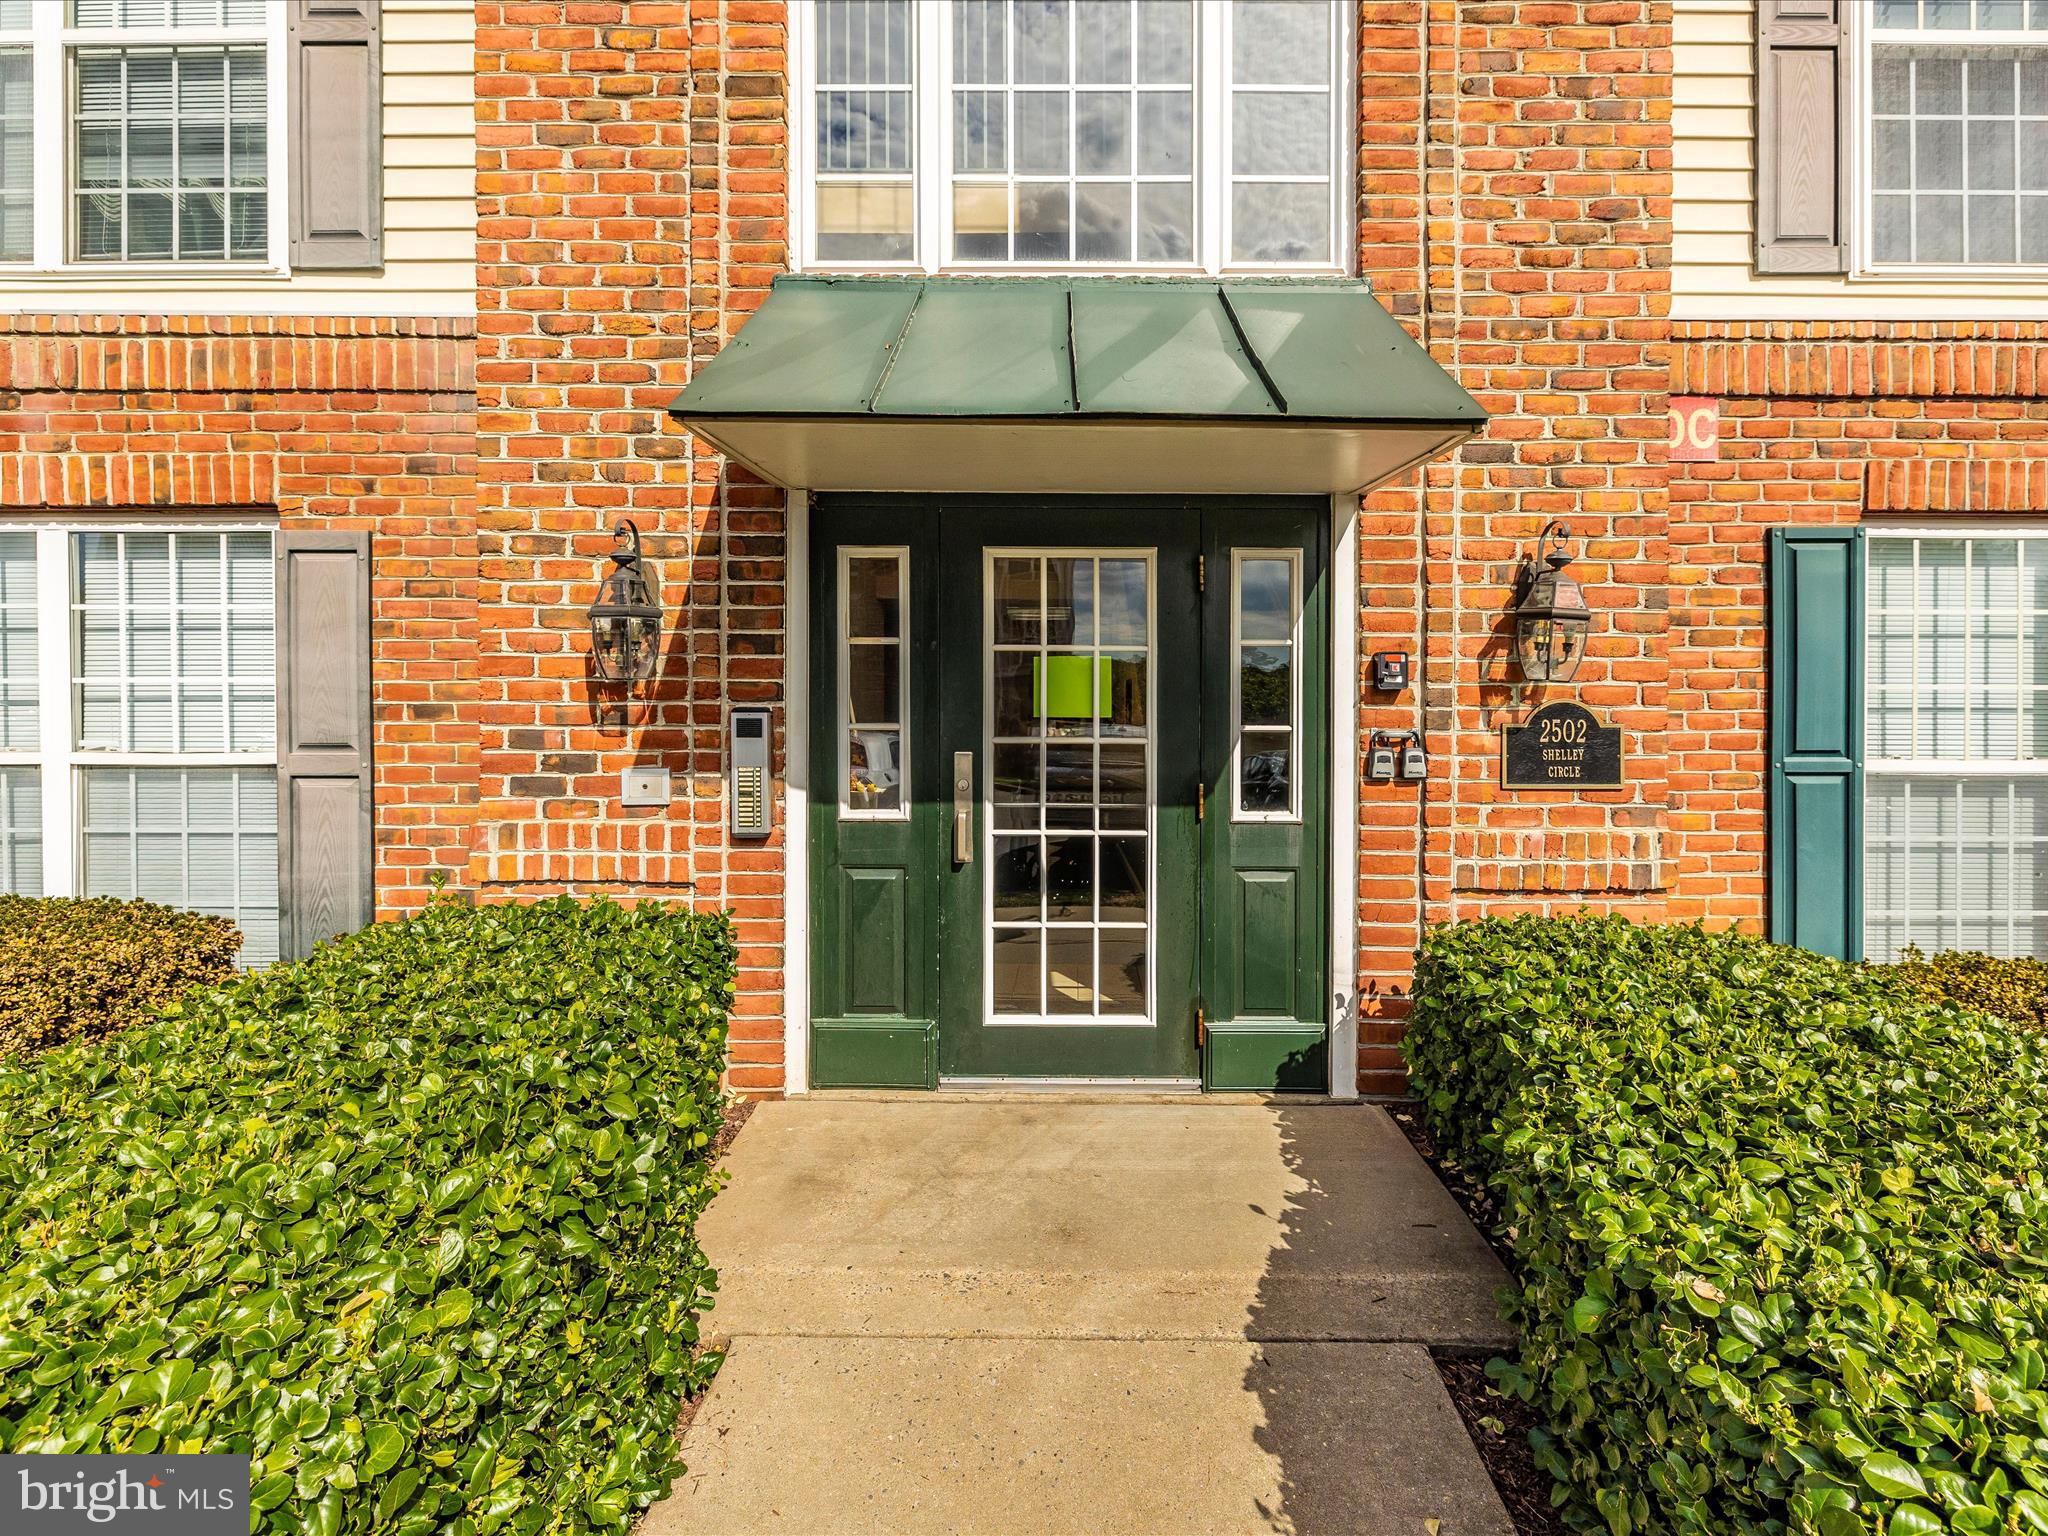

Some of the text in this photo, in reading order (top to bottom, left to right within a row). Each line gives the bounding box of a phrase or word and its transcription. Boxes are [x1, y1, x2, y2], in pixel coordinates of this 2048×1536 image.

[1539, 719, 1587, 743] 2502
[1542, 749, 1584, 761] SHELLEY
[1548, 766, 1581, 778] CIRCLE
